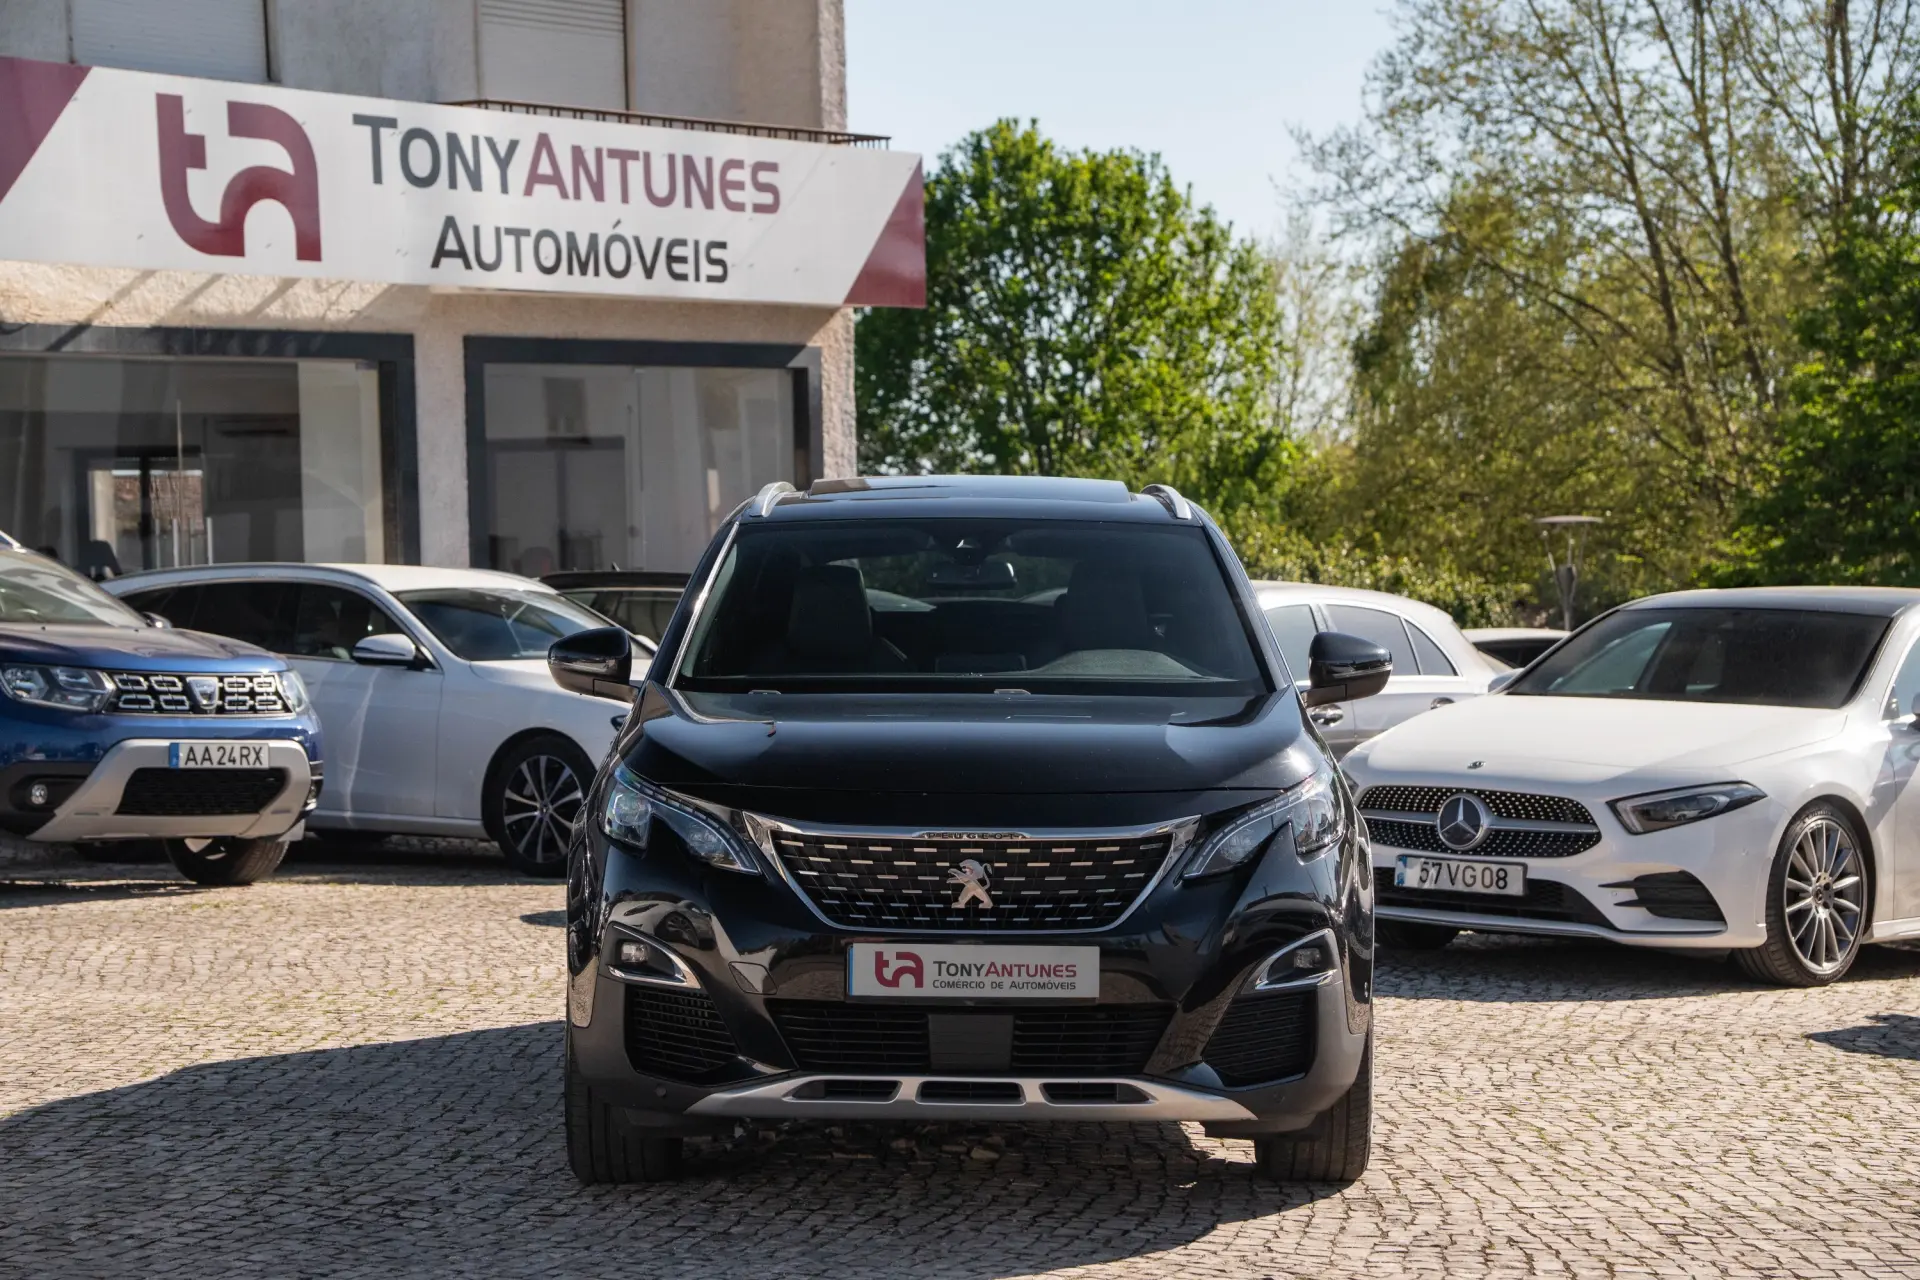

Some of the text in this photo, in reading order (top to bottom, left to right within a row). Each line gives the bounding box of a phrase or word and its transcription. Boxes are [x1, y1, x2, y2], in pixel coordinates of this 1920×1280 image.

[430, 215, 729, 283] AUTOMÓVEIS
[184, 746, 263, 766] AA24RX
[926, 831, 1016, 840] PEUGEOT
[1419, 861, 1508, 890] 57VG08
[932, 978, 1077, 991] COMÉRCIO DE AUTOMÓVEIS
